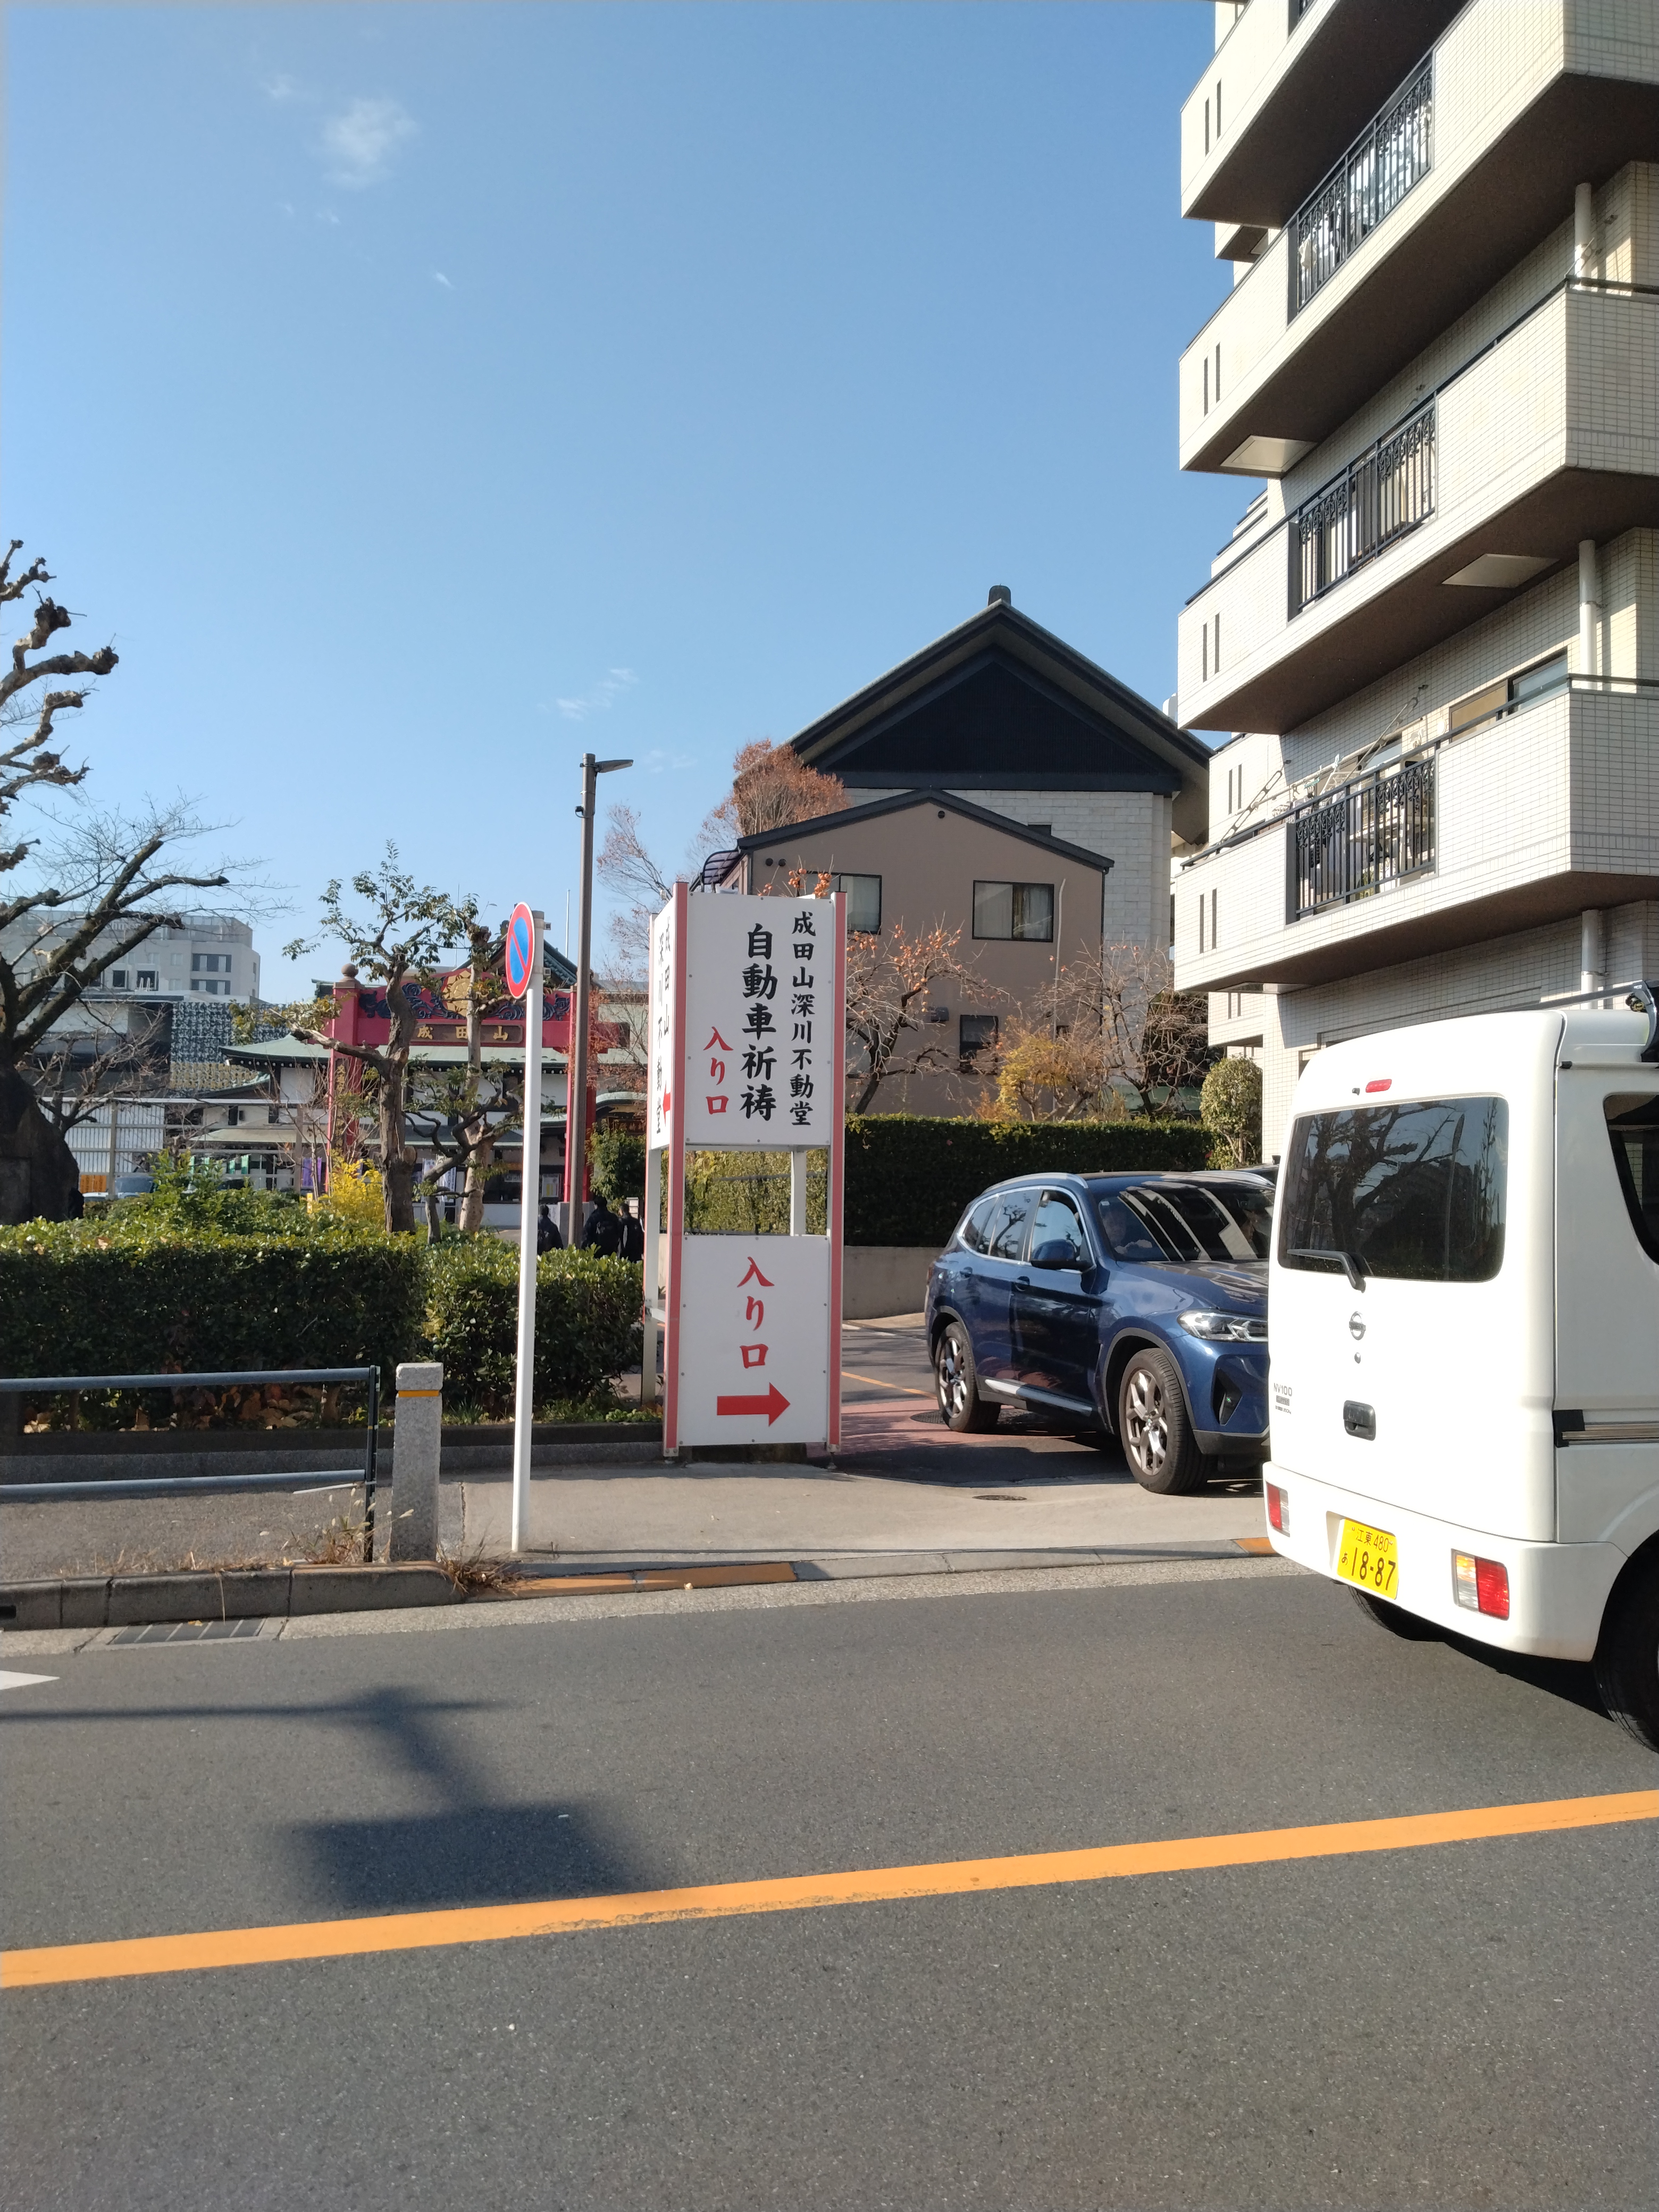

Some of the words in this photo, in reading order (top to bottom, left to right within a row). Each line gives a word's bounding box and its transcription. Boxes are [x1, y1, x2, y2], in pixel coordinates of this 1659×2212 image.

[417, 1026, 508, 1041] 成田山
[739, 923, 778, 1121] 自動車祈祷
[789, 911, 816, 1126] 成田山深川不動堂
[703, 1026, 733, 1115] 入り口
[737, 1256, 775, 1369] 入り口
[1273, 1382, 1293, 1397] NV100
[1341, 1552, 1348, 1566] あ
[1349, 1547, 1396, 1591] 18-87
[1355, 1528, 1373, 1546] 江東
[1373, 1534, 1389, 1553] 480
